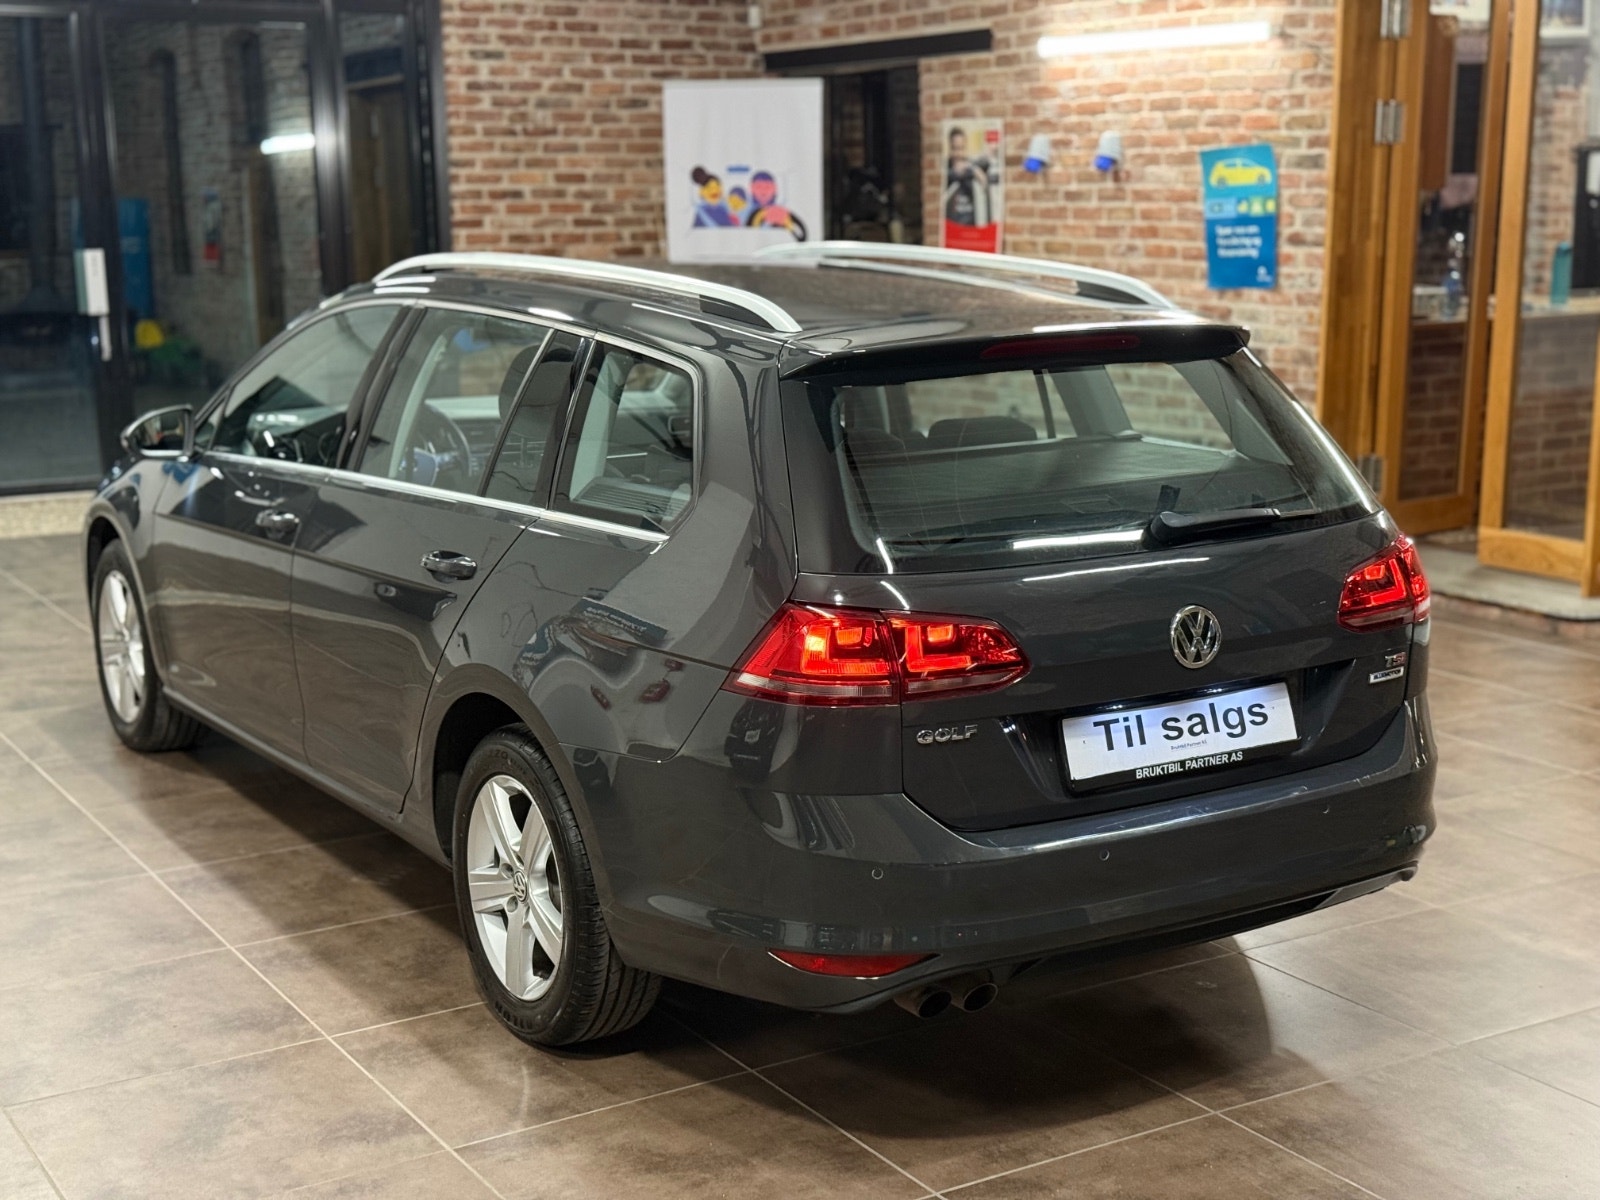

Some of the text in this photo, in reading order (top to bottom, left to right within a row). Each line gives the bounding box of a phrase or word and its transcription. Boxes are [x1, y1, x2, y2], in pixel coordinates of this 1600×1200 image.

[916, 724, 978, 745] GOLF
[1093, 702, 1269, 752] Til salgs
[1135, 751, 1243, 779] BRUKTBIL PARTNER AS
